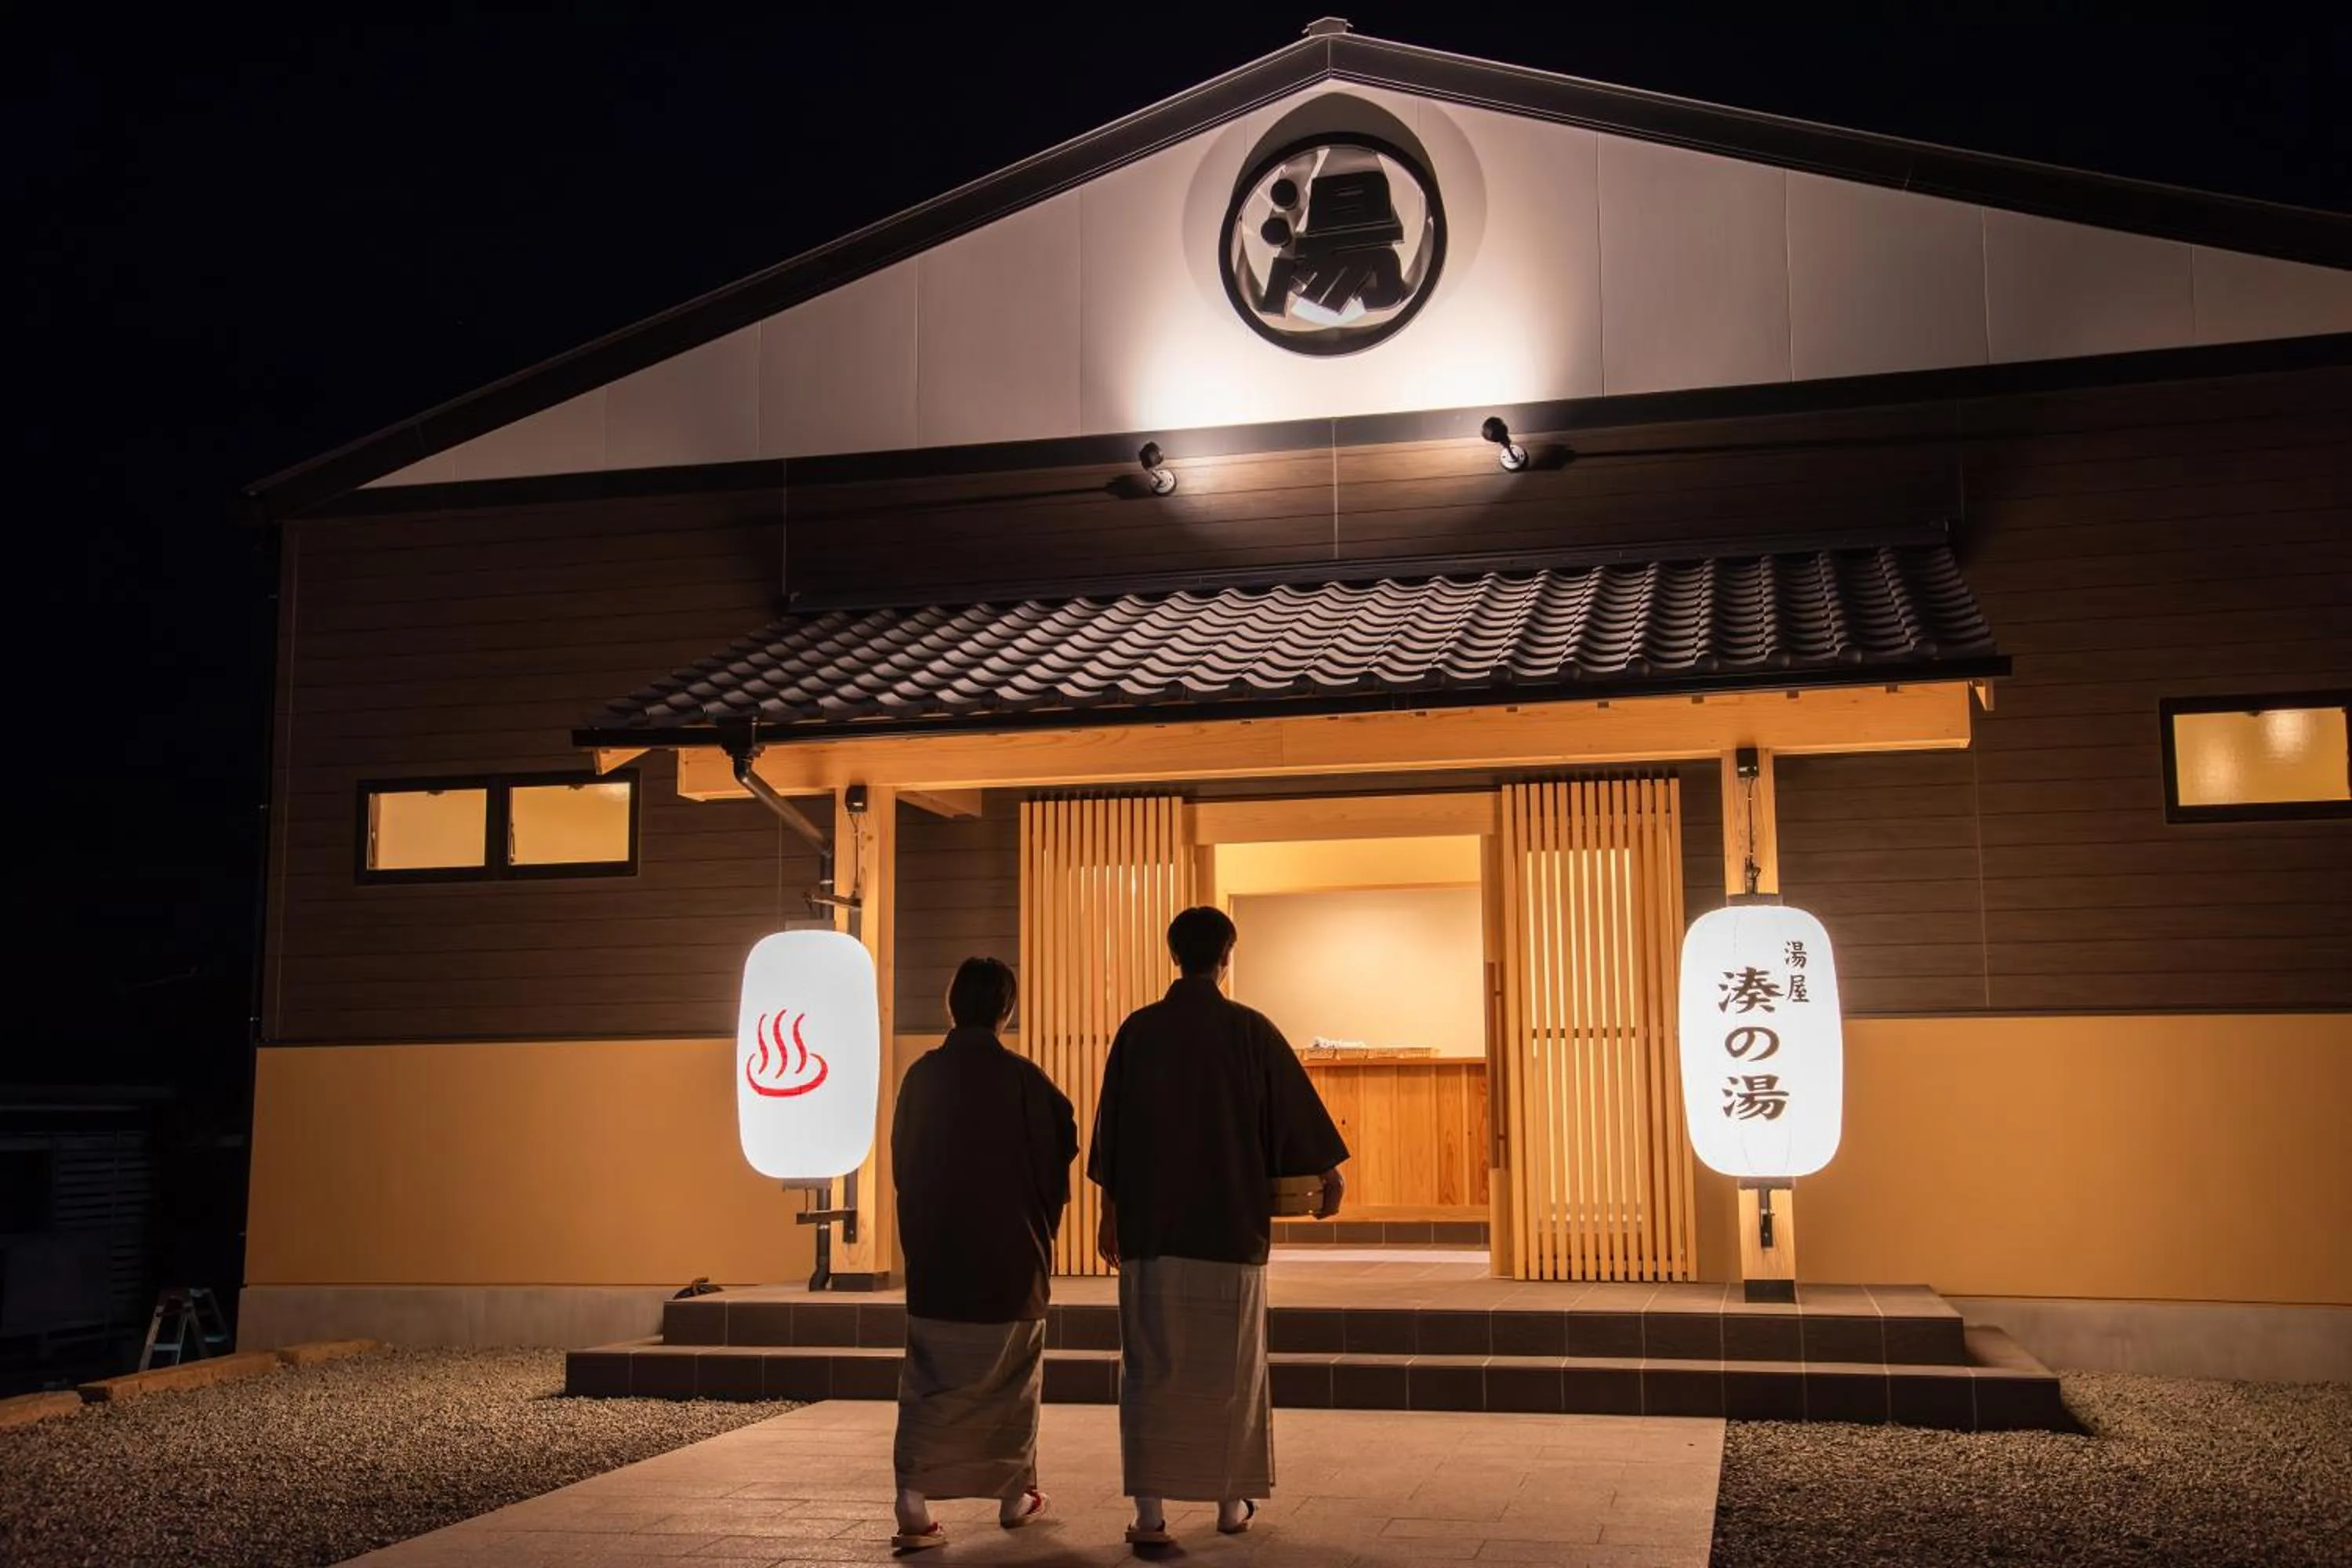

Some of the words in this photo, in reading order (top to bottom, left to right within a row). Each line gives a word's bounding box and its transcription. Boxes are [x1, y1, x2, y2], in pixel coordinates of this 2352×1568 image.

[1784, 940, 1809, 1004] 湯屋
[1718, 966, 1790, 1120] 湊の湯
